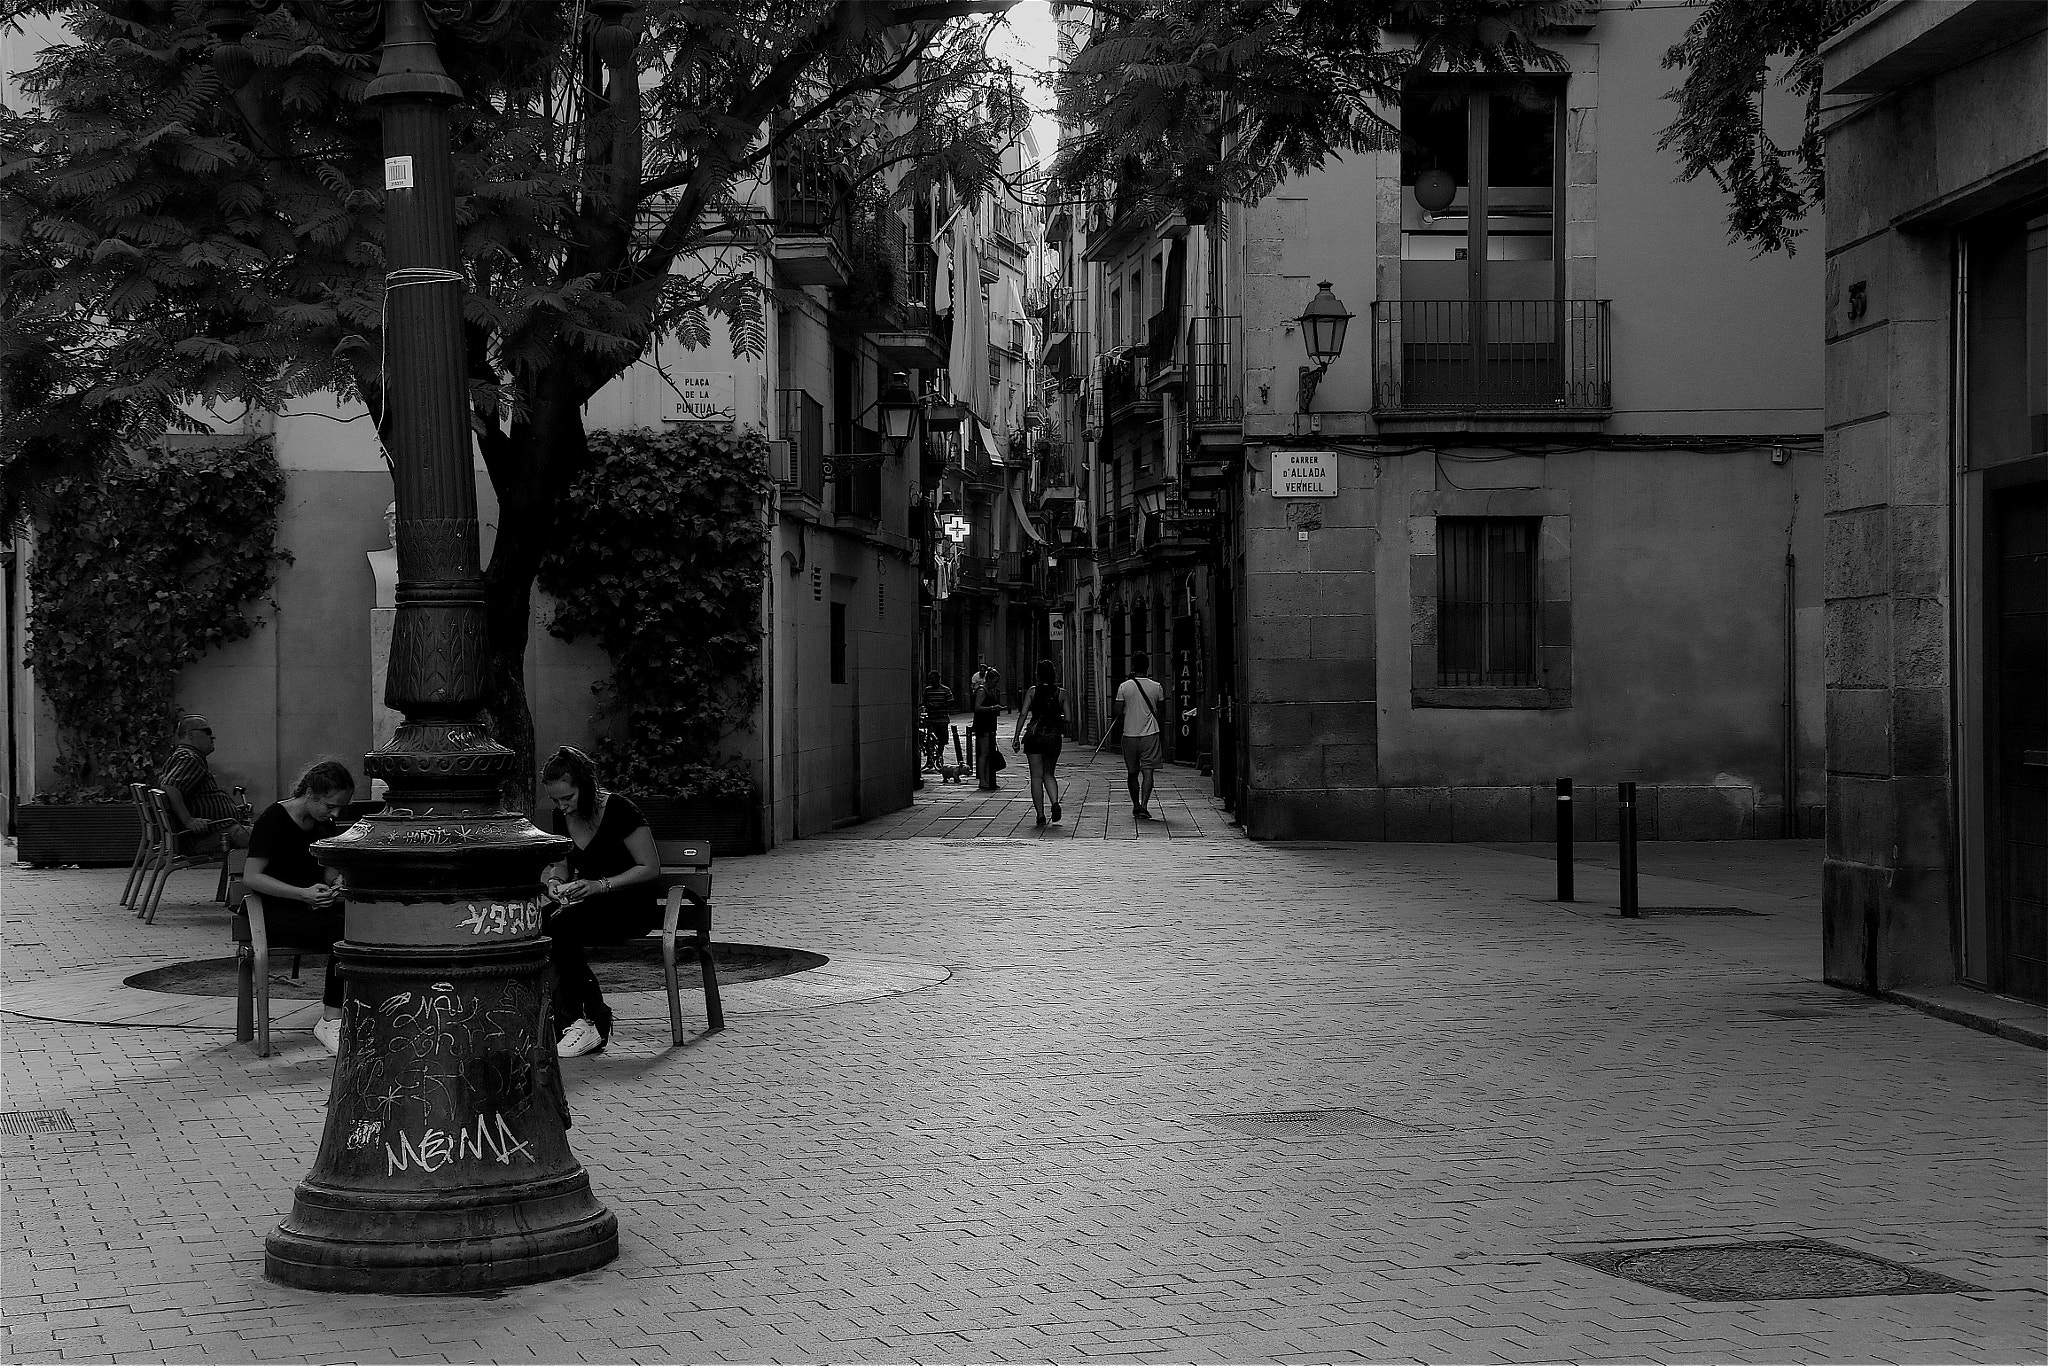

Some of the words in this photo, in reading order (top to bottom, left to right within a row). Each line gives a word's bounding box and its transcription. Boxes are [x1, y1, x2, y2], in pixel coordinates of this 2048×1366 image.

[685, 378, 710, 387] PLAÇA
[685, 391, 695, 399] DE
[699, 391, 709, 399] LA
[676, 403, 716, 414] PUNTUAL
[1290, 456, 1318, 464] CARRER
[1285, 482, 1324, 492] VERMELL
[1180, 649, 1191, 737] TATTOO
